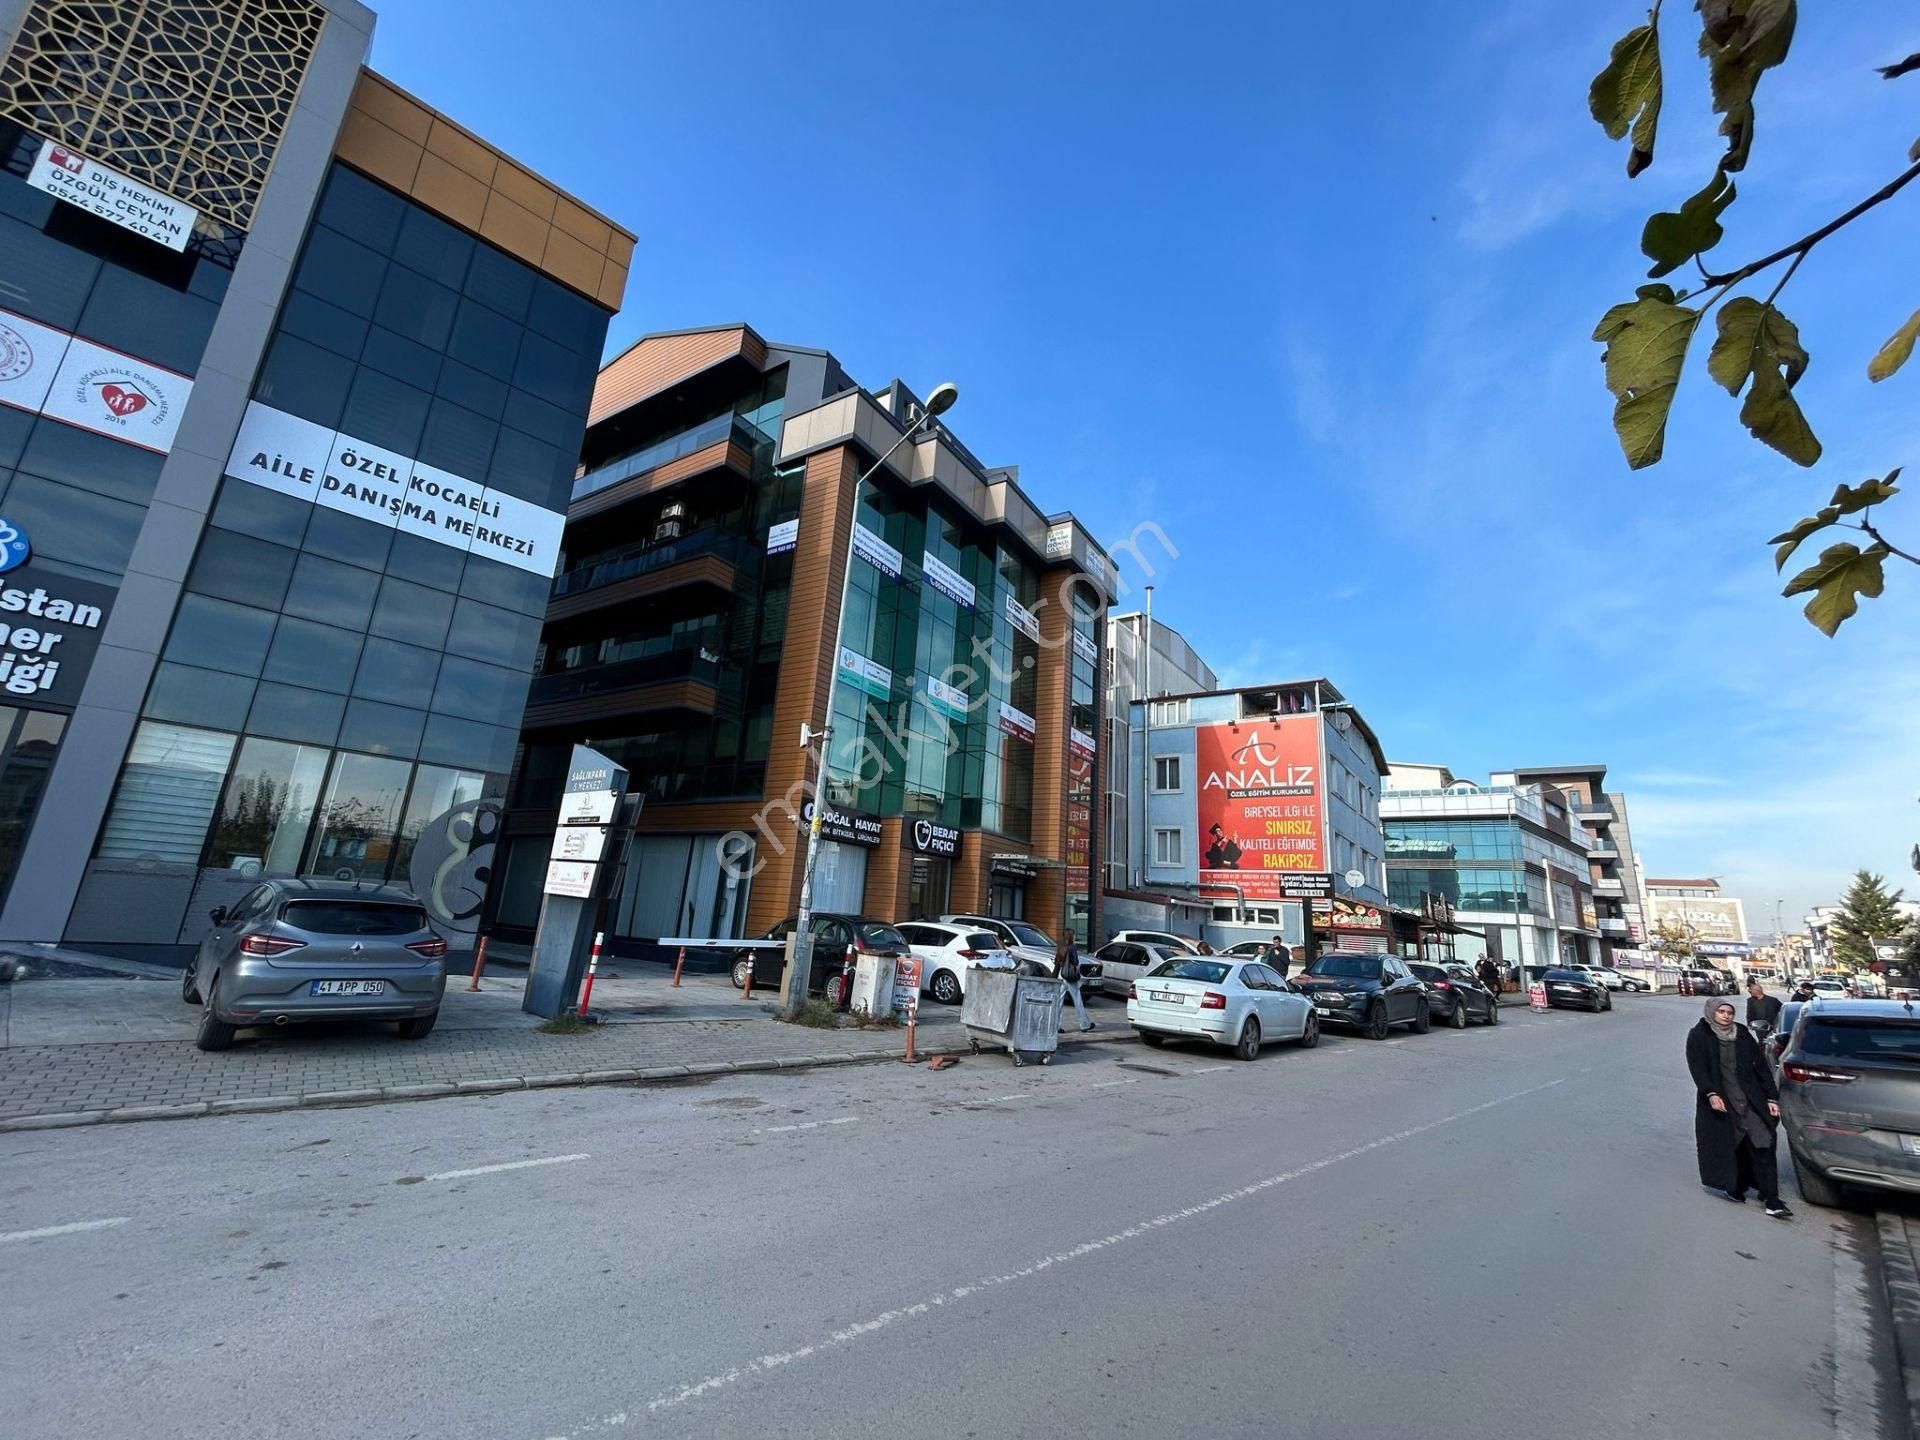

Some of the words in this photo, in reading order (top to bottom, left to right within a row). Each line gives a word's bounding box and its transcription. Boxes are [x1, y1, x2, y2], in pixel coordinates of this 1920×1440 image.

[92, 172, 118, 190] DİŞ
[122, 186, 175, 216] HEKİMİ
[52, 169, 110, 204] ÖZGÜL
[115, 199, 181, 235] CEYLAN
[46, 184, 88, 208] 0544
[95, 206, 124, 222] 577
[129, 222, 148, 234] 40
[152, 233, 170, 244] 41
[104, 414, 126, 426] 2018
[340, 447, 400, 484] ÖZEL
[410, 475, 501, 518] KOCAELİ
[250, 452, 314, 484] AİLE
[322, 474, 437, 526] DANIŞMA
[444, 516, 536, 557] MERKEZİ
[858, 549, 872, 562] 0505
[872, 557, 882, 570] 922
[1203, 764, 1314, 790] ANALİZ
[1230, 789, 1246, 798] ÖZEL
[1248, 788, 1270, 798] EĞİTİM
[1272, 788, 1311, 796] KURUMLARI
[1244, 806, 1282, 818] BİREYSEL
[1284, 806, 1300, 818] İLGİ
[1302, 805, 1316, 816] İLE
[856, 818, 882, 833] HAYAT
[1266, 820, 1316, 836] SINIRSIZ,
[832, 828, 855, 839] BİTKİSEL
[858, 832, 880, 844] ÜRÜNLER
[932, 826, 959, 841] BERAT
[932, 838, 954, 852] FIÇICI
[1240, 838, 1276, 850] KALİTELİ
[1278, 836, 1316, 850] EĞİTİMDE
[1264, 854, 1318, 868] RAKİPSİZ.
[319, 980, 332, 993] 41
[336, 980, 358, 992] APP
[363, 980, 383, 992] 050
